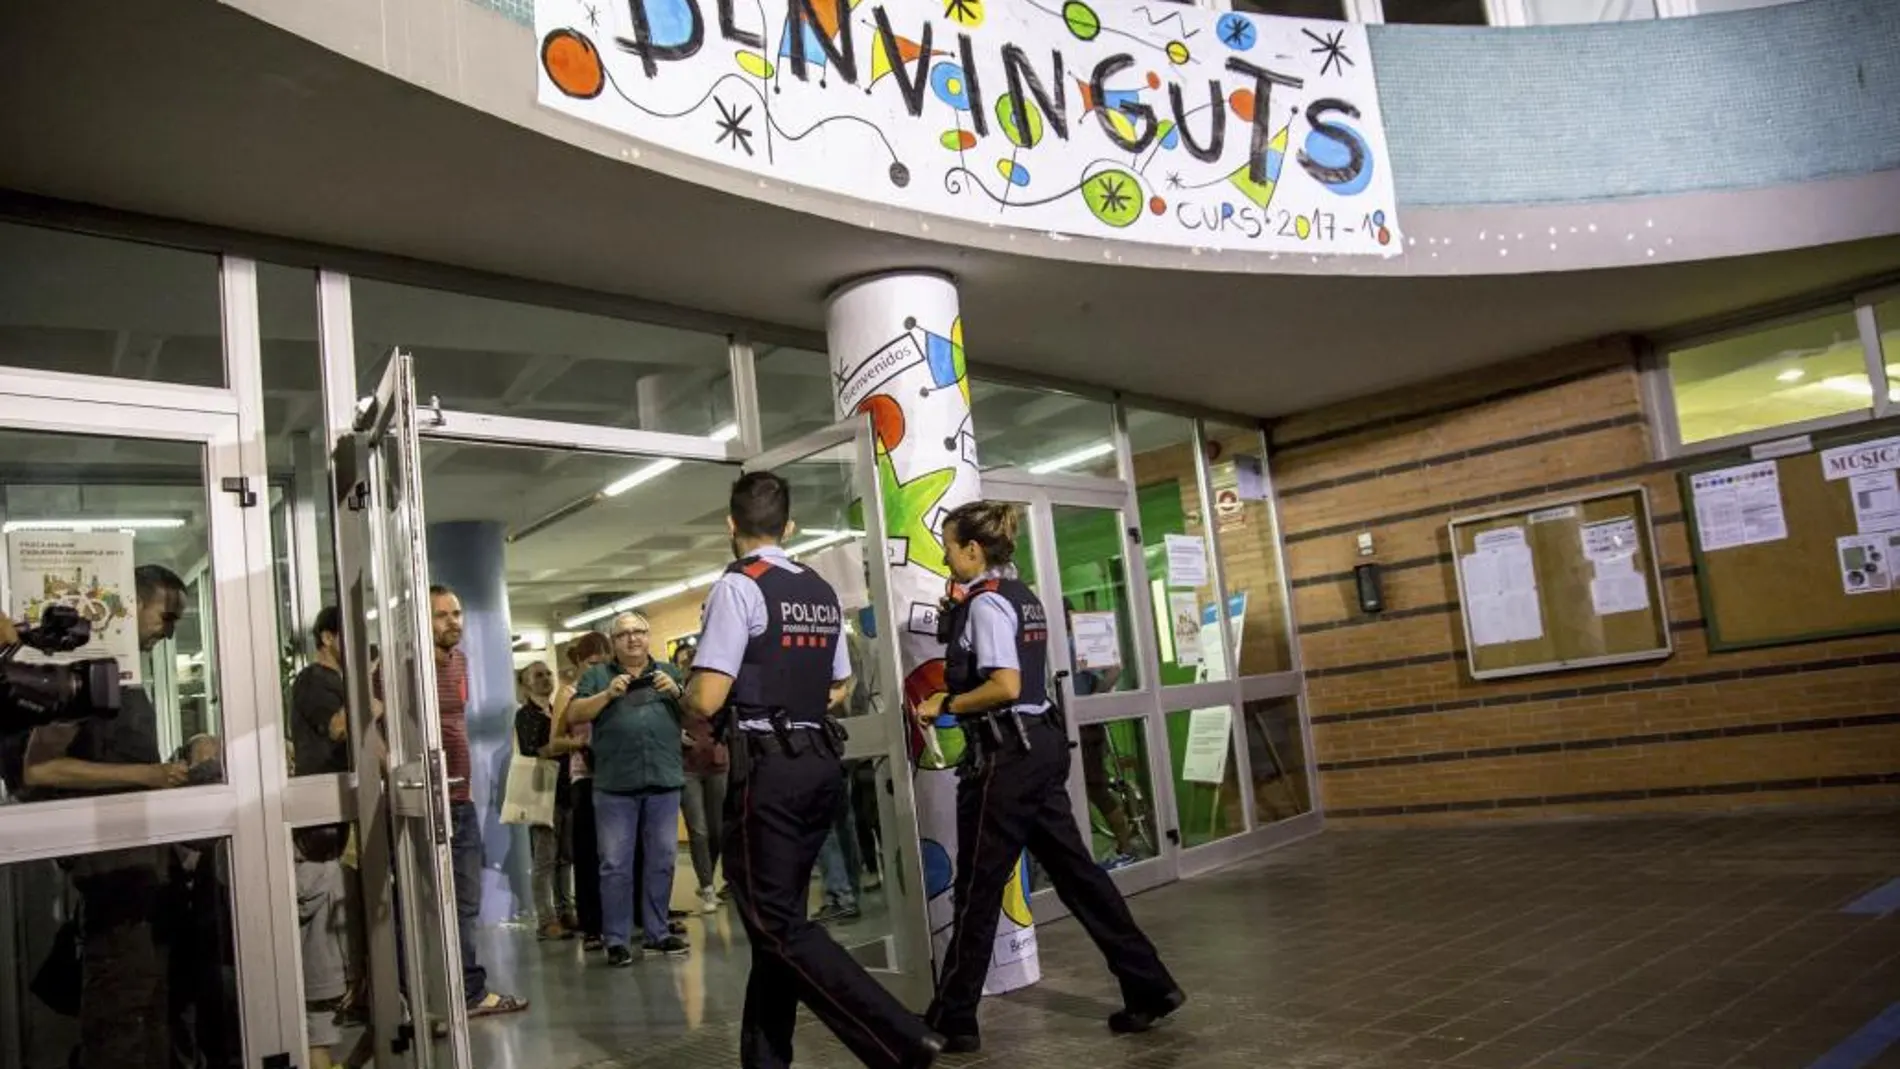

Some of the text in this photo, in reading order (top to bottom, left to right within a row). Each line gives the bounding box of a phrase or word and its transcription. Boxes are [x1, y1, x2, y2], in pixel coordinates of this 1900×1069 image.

[1176, 202, 1262, 238] CURS
[843, 346, 911, 404] Bienvenidos
[1828, 447, 1900, 474] MUSIC
[781, 601, 840, 624] POLICIA
